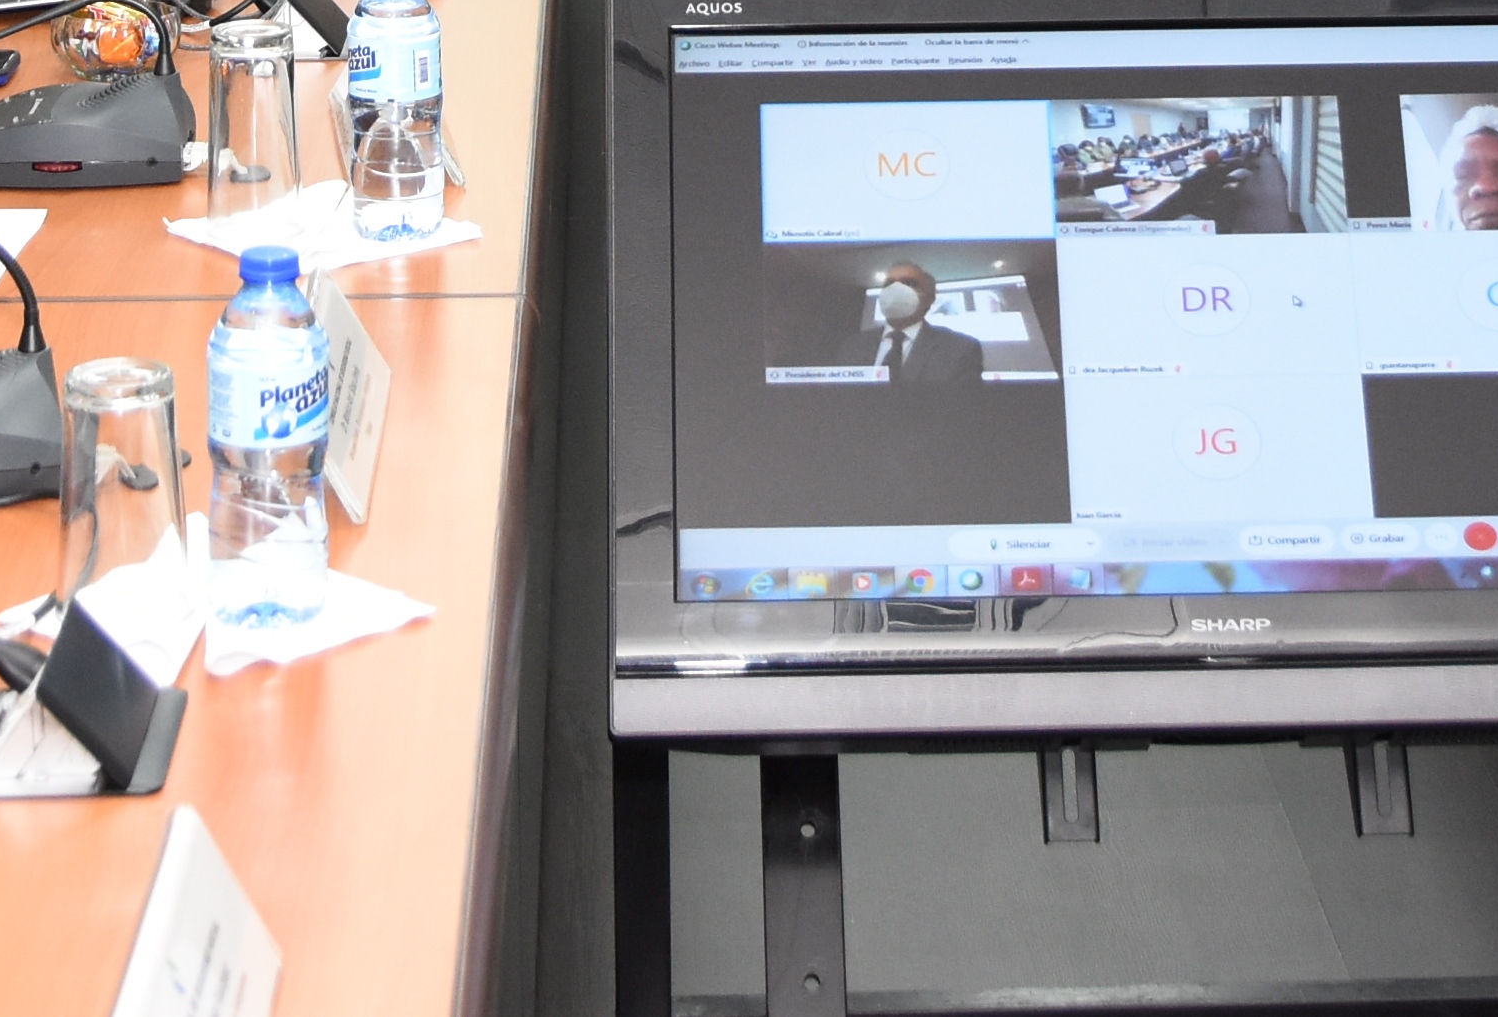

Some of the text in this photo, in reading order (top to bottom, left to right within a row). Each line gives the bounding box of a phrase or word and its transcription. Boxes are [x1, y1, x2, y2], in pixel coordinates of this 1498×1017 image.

[685, 2, 743, 15] AQUOS
[349, 50, 376, 71] azul
[678, 59, 710, 68] Archivo
[718, 59, 743, 68] Editar
[751, 58, 794, 69] Compartir
[802, 58, 816, 67] Ver
[825, 57, 849, 66] Audio
[891, 56, 940, 66] Participante
[991, 55, 1017, 65] Ayuda
[878, 152, 936, 177] MC
[1182, 286, 1233, 313] DR
[260, 365, 329, 408] Planeta
[1195, 428, 1237, 455] JG
[1006, 539, 1051, 549] Silenciar
[1267, 534, 1320, 547] Compartir
[1369, 533, 1405, 544] Grabar
[1191, 618, 1271, 632] SHARP
